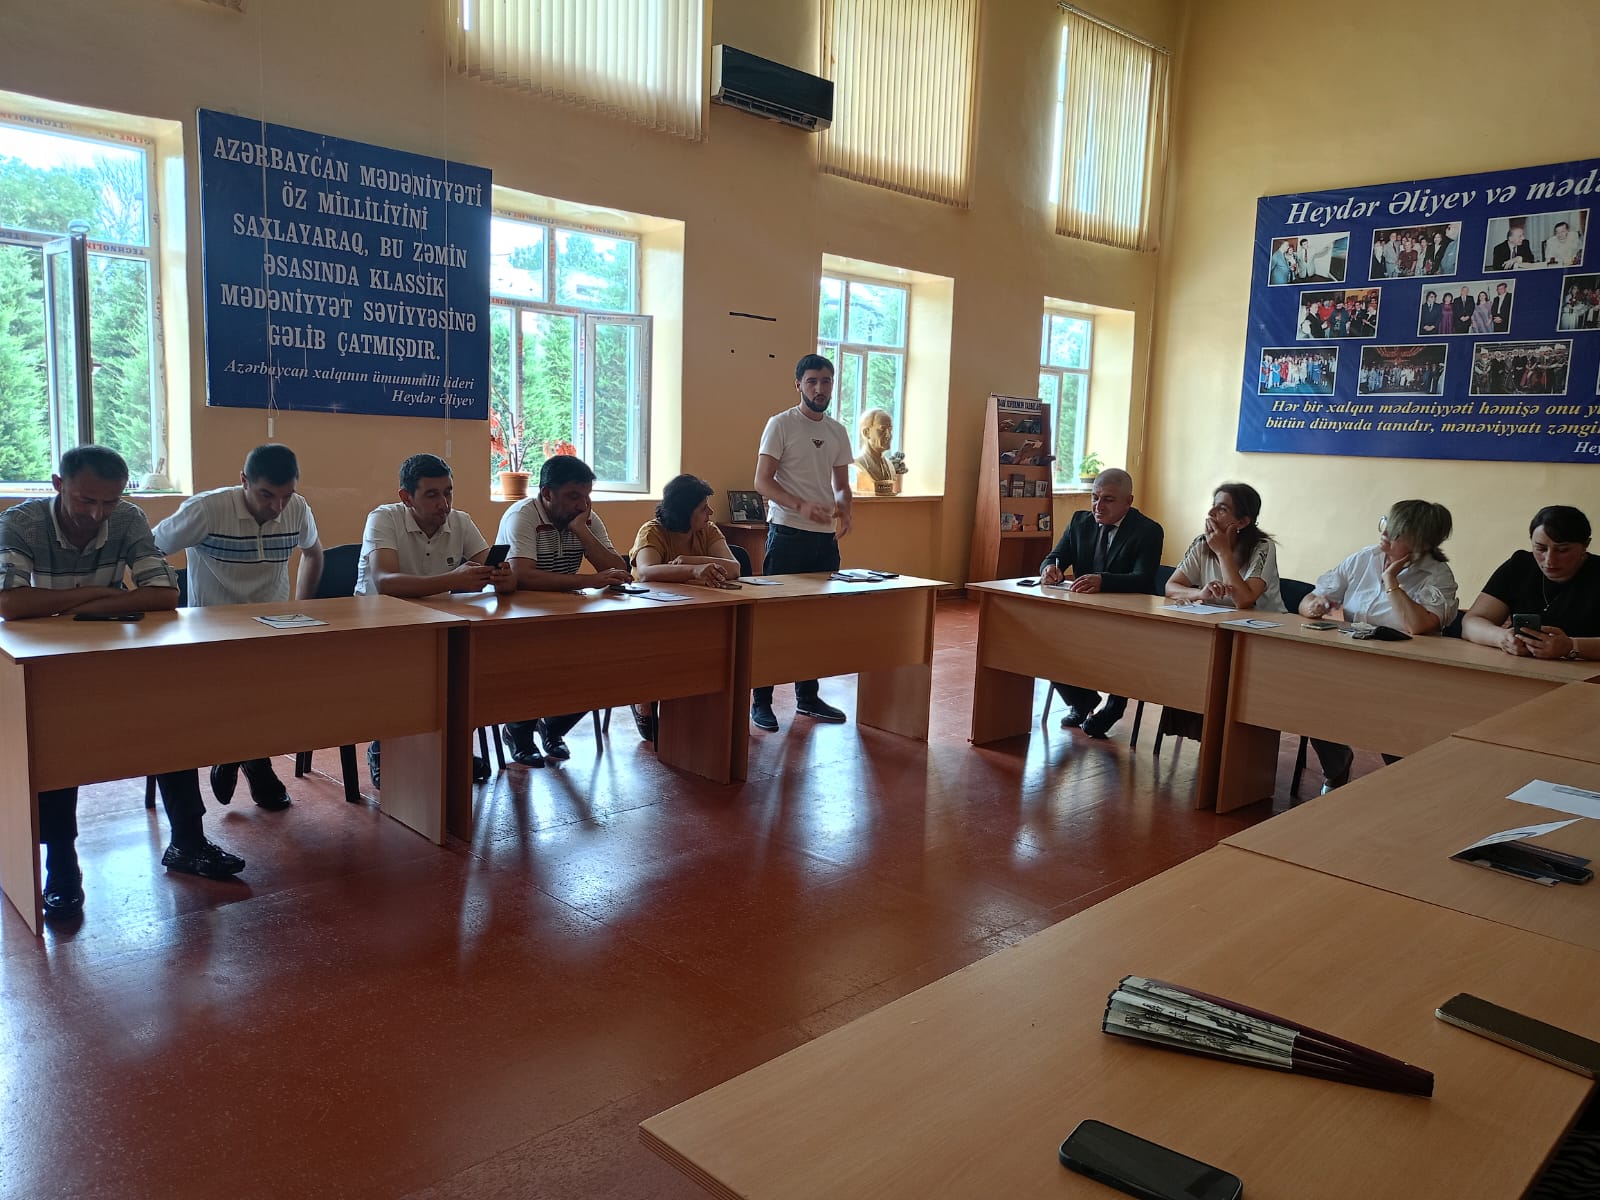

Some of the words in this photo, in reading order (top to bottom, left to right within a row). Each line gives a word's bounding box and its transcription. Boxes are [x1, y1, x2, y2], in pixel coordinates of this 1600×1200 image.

[213, 136, 349, 183] AZƏRBAYCAN
[360, 165, 483, 207] MƏDƏNİYYƏTİ
[282, 180, 307, 210] ÖZ
[318, 190, 428, 231] MİLLİLİYİNİ
[1285, 197, 1380, 228] Heydər
[1388, 188, 1477, 217] Əliyev
[1486, 184, 1517, 204] və
[86, 242, 145, 256] TECHNOLIN
[233, 213, 369, 257] SAXLAYARAQ,
[380, 236, 404, 259] BU
[413, 241, 468, 269] ZƏMİN
[263, 253, 360, 287] ƏSASINDA
[369, 268, 445, 298] KLASSİK
[220, 283, 353, 319] MƏDƏNİYYƏT
[363, 301, 477, 333] SƏVİYYƏSİNƏ
[268, 323, 326, 350] GƏLİB
[337, 331, 441, 362] ÇATMIŞDIR.
[224, 359, 308, 379] Azərbaycan
[312, 367, 368, 384] xalqının
[373, 371, 440, 387] ümummilli
[443, 376, 474, 390] lideri
[392, 389, 436, 406] Heydər
[439, 393, 474, 409] Əliyev
[1271, 400, 1300, 412] Hər
[1302, 400, 1323, 413] bir
[1326, 401, 1374, 417] xalqın
[1378, 401, 1475, 417] mədəniyyəti
[1478, 401, 1540, 418] həmişə
[1545, 405, 1581, 415] onu
[1265, 417, 1305, 429] bütün
[1309, 418, 1373, 433] dünyada
[1376, 419, 1435, 434] tanıdır,
[1440, 420, 1542, 437] mənəviyyatı
